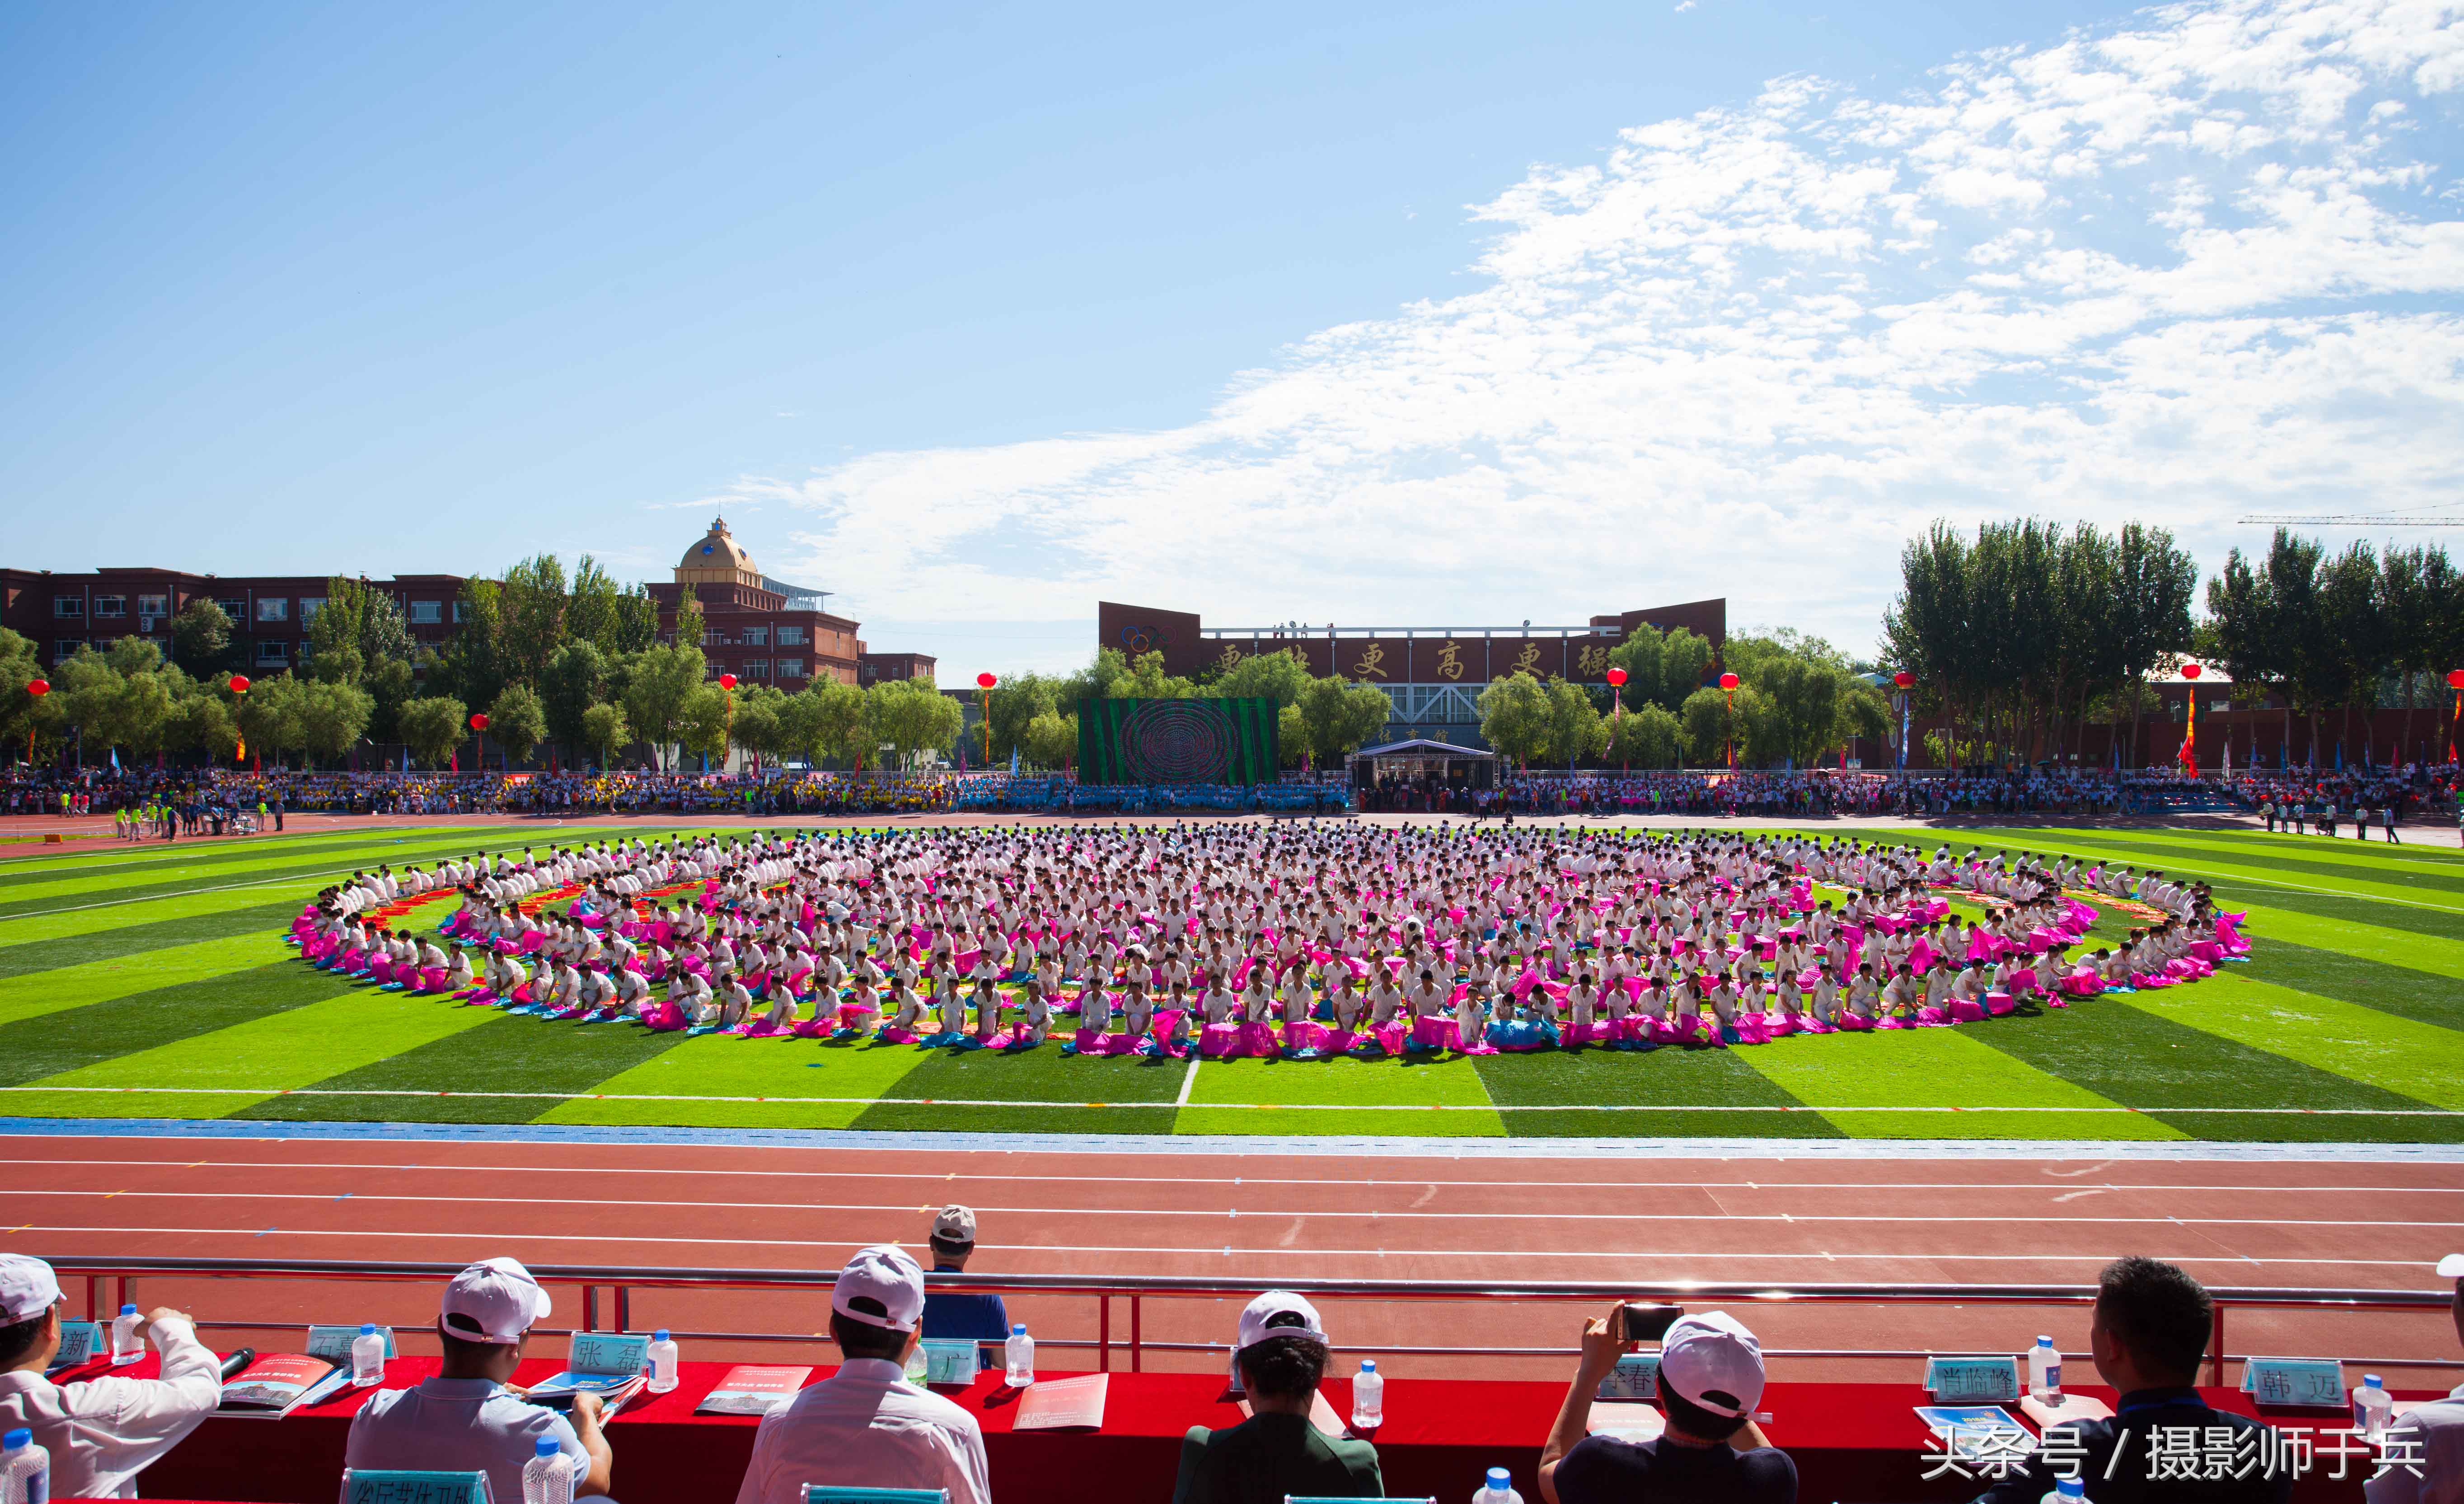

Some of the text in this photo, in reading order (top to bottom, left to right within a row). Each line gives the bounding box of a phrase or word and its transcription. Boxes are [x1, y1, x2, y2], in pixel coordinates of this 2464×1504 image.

[1378, 729, 1449, 743] 体育馆
[578, 1340, 642, 1371] 张磊
[1604, 1364, 1656, 1391] 李春
[1943, 1367, 2014, 1396] 肖临峰
[2261, 1369, 2341, 1401] 韩迈
